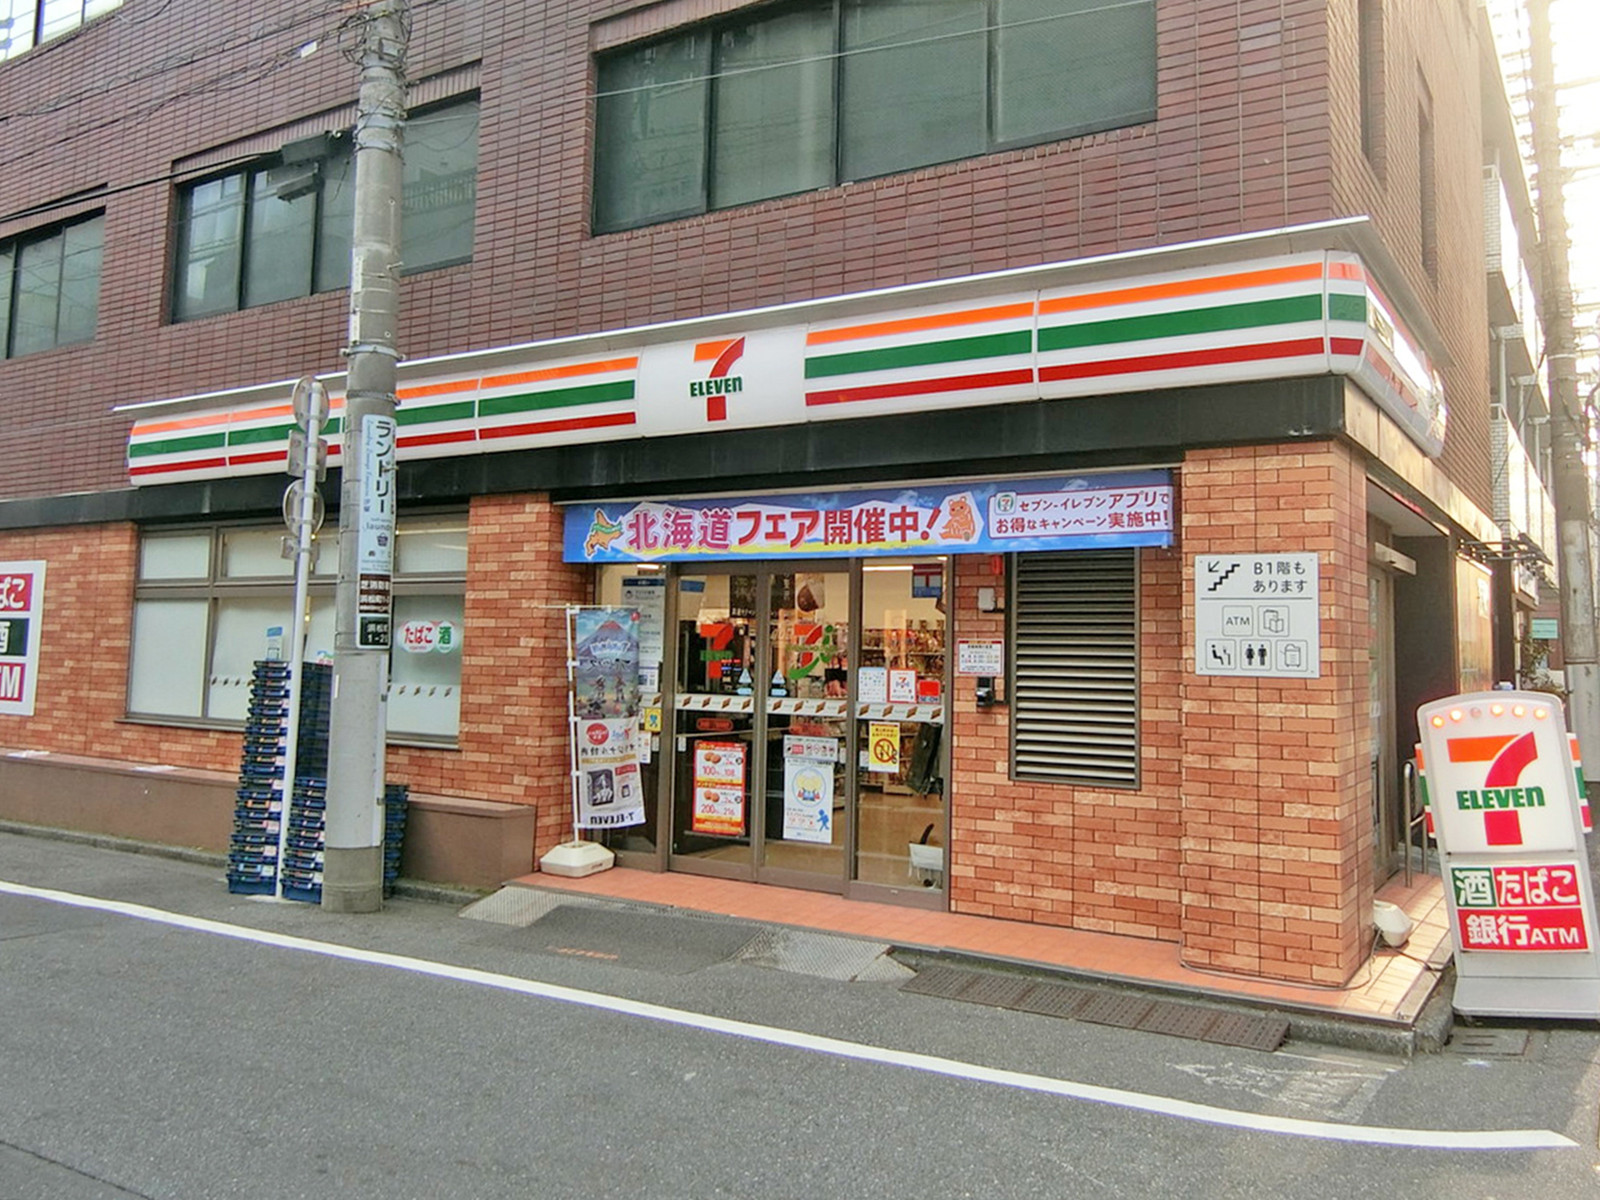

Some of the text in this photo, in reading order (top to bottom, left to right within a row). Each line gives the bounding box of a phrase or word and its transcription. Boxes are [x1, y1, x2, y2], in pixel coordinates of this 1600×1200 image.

[694, 336, 745, 422] 7
[627, 505, 941, 551] 北海道フェア開催中!
[996, 510, 1169, 534] お得なキャンペーン実施中!
[1253, 561, 1306, 576] B1階も
[1253, 579, 1308, 593] あります
[404, 625, 433, 644] たばこ
[1226, 616, 1250, 626] ATM
[438, 626, 452, 645] 酒
[1447, 731, 1538, 846] 7
[1454, 870, 1493, 906] 酒
[1496, 868, 1577, 905] たばこ
[1466, 914, 1580, 945] 銀行ATM
